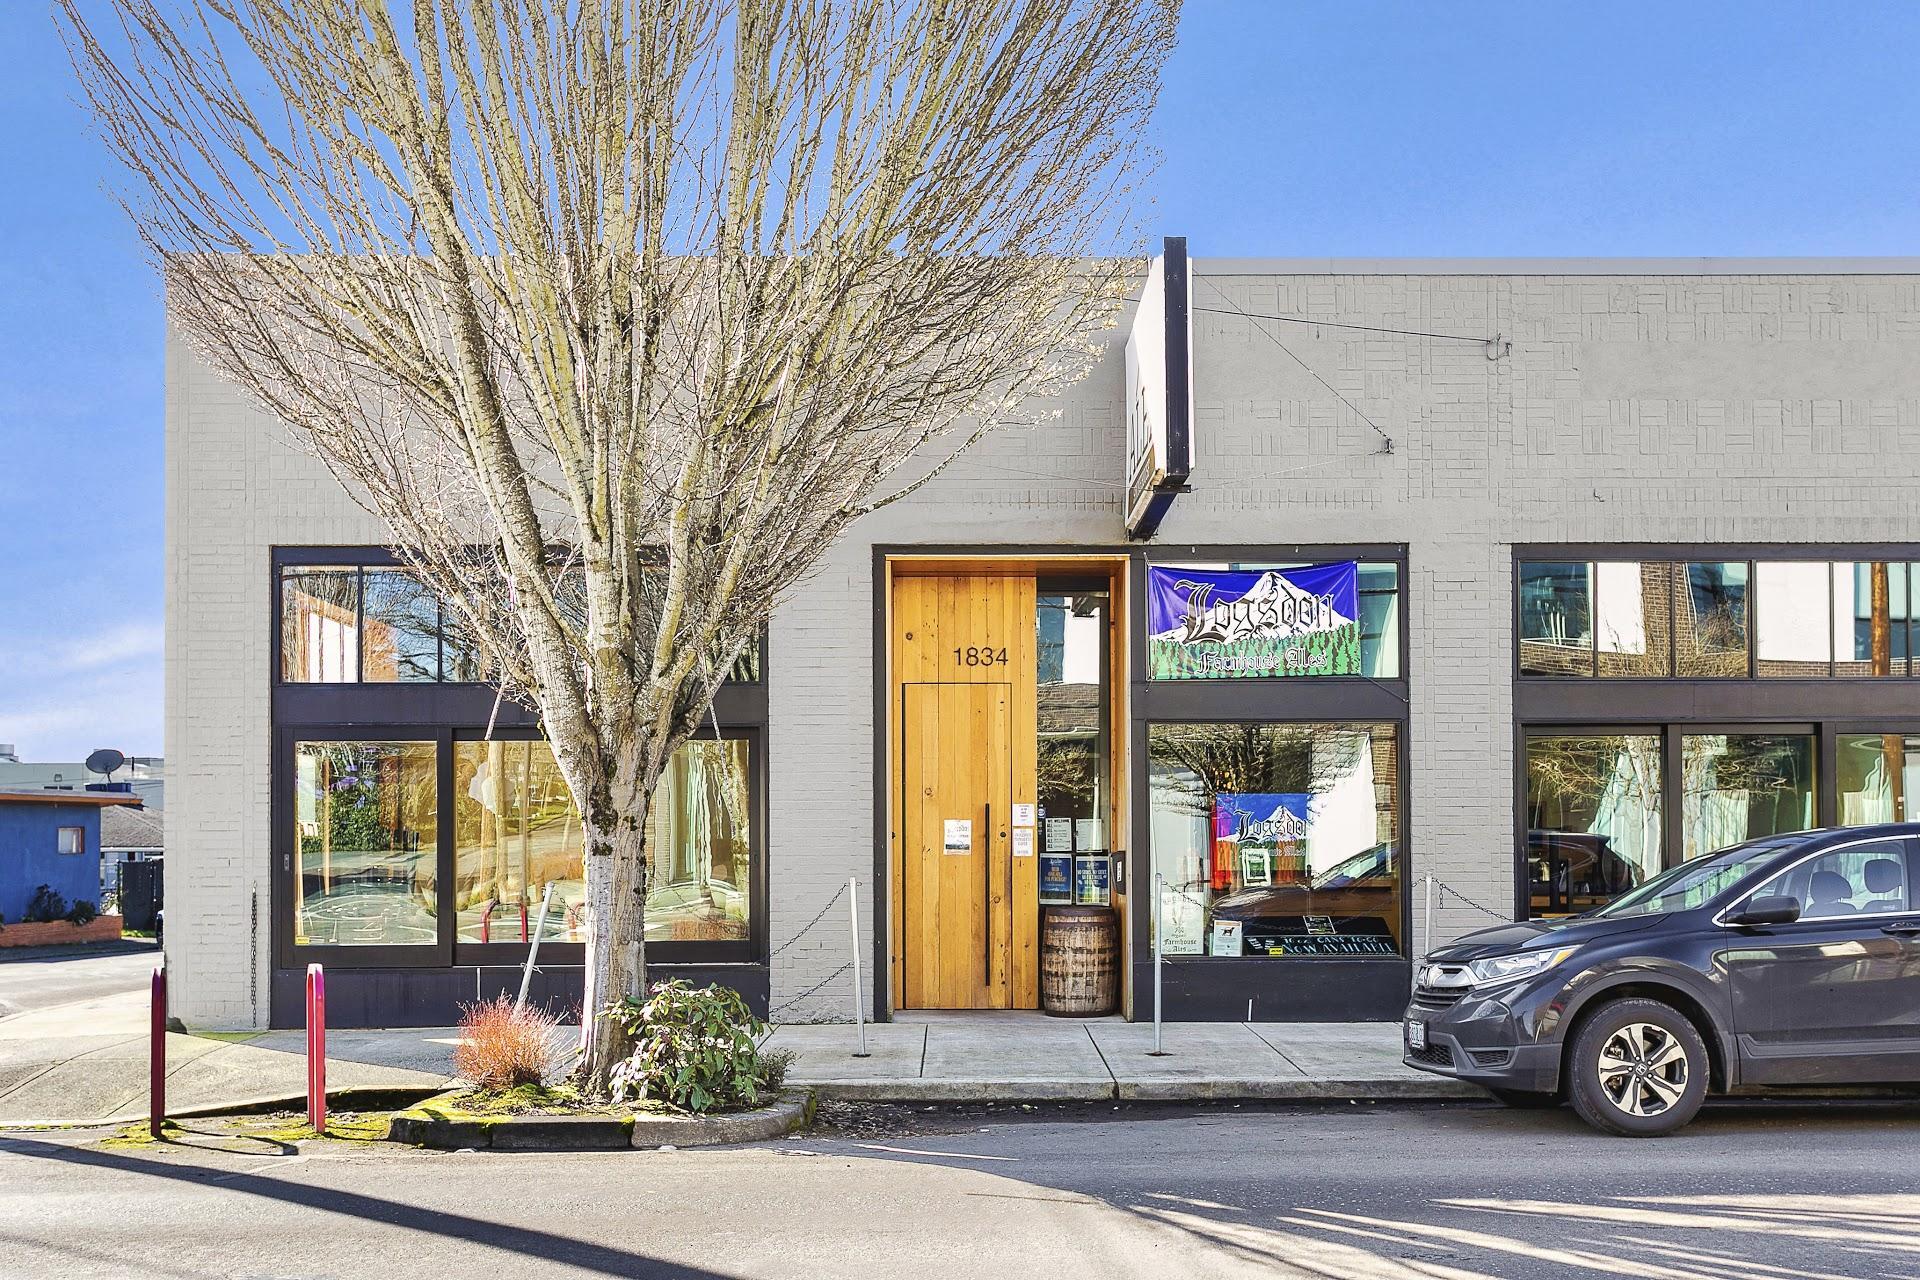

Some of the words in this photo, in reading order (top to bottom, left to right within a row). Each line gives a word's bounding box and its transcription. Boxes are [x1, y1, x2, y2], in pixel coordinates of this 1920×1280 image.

[1174, 579, 1334, 644] Logsdon
[953, 647, 1008, 666] 1834
[1197, 651, 1280, 675] Farmhouse
[1285, 646, 1327, 668] Ales
